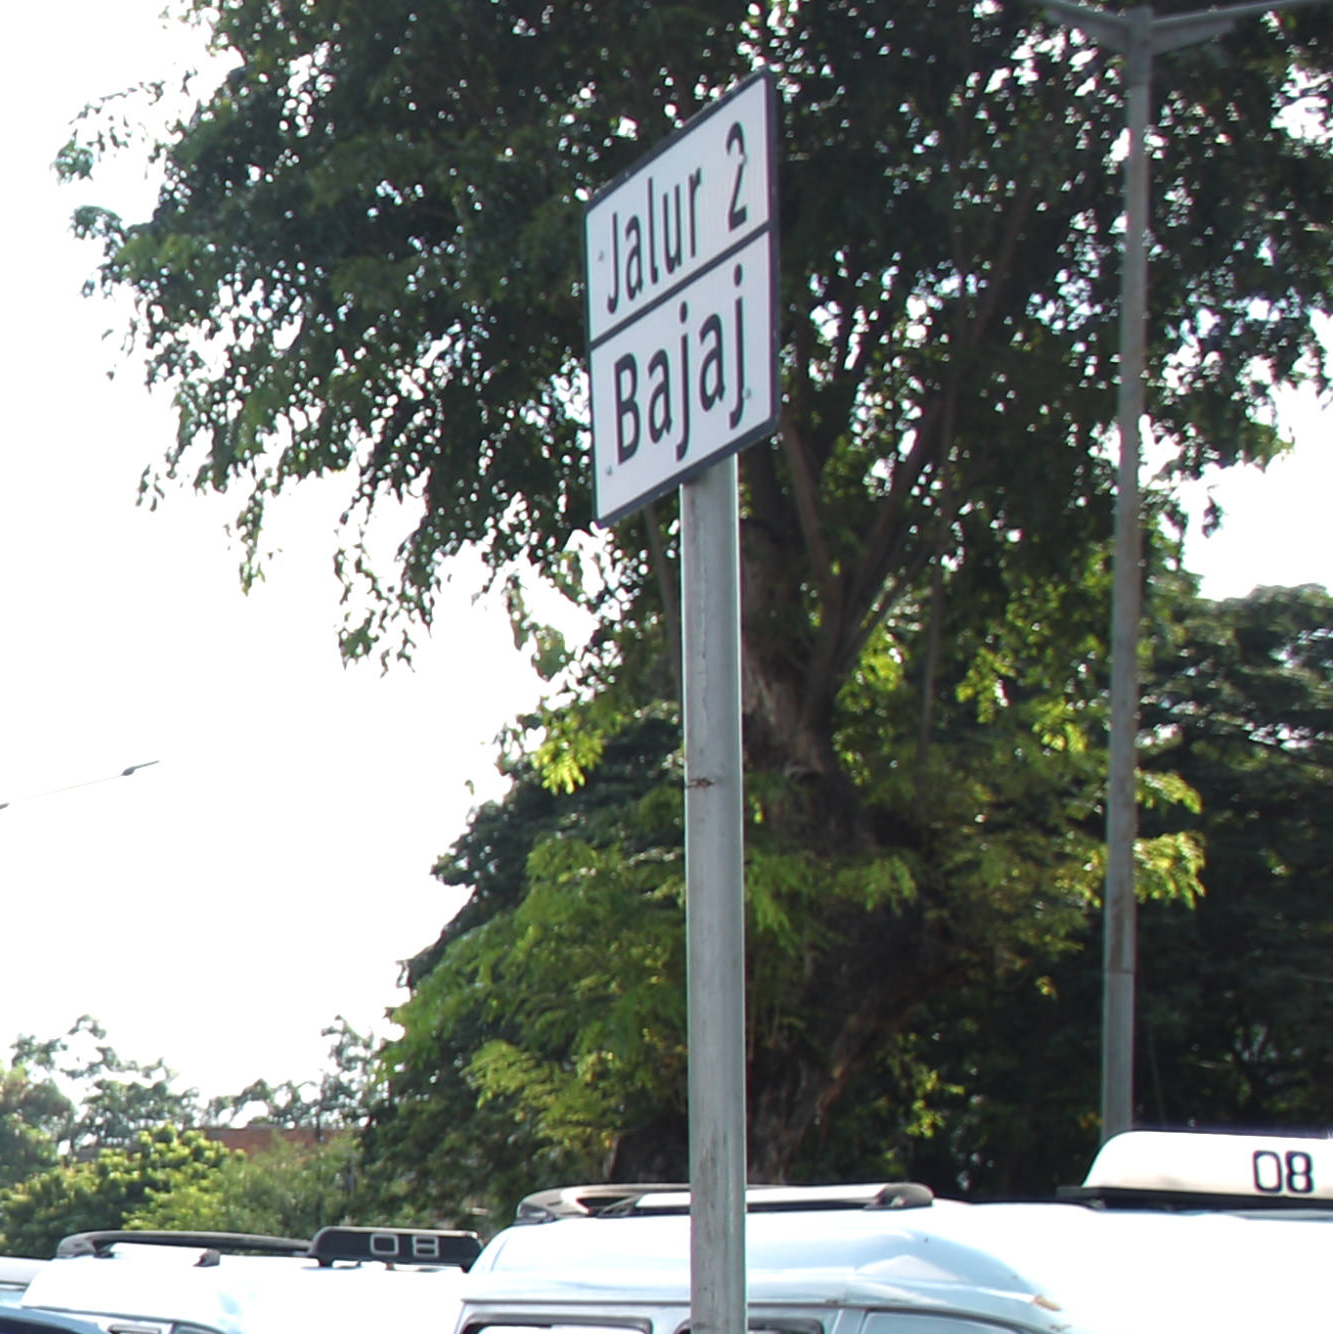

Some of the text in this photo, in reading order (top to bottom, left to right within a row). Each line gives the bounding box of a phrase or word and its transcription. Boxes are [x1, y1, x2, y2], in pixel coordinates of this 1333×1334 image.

[607, 121, 749, 315] Jalur 2
[614, 263, 746, 467] Bajaj
[1252, 1149, 1315, 1194] 08
[370, 1233, 439, 1258] 08
